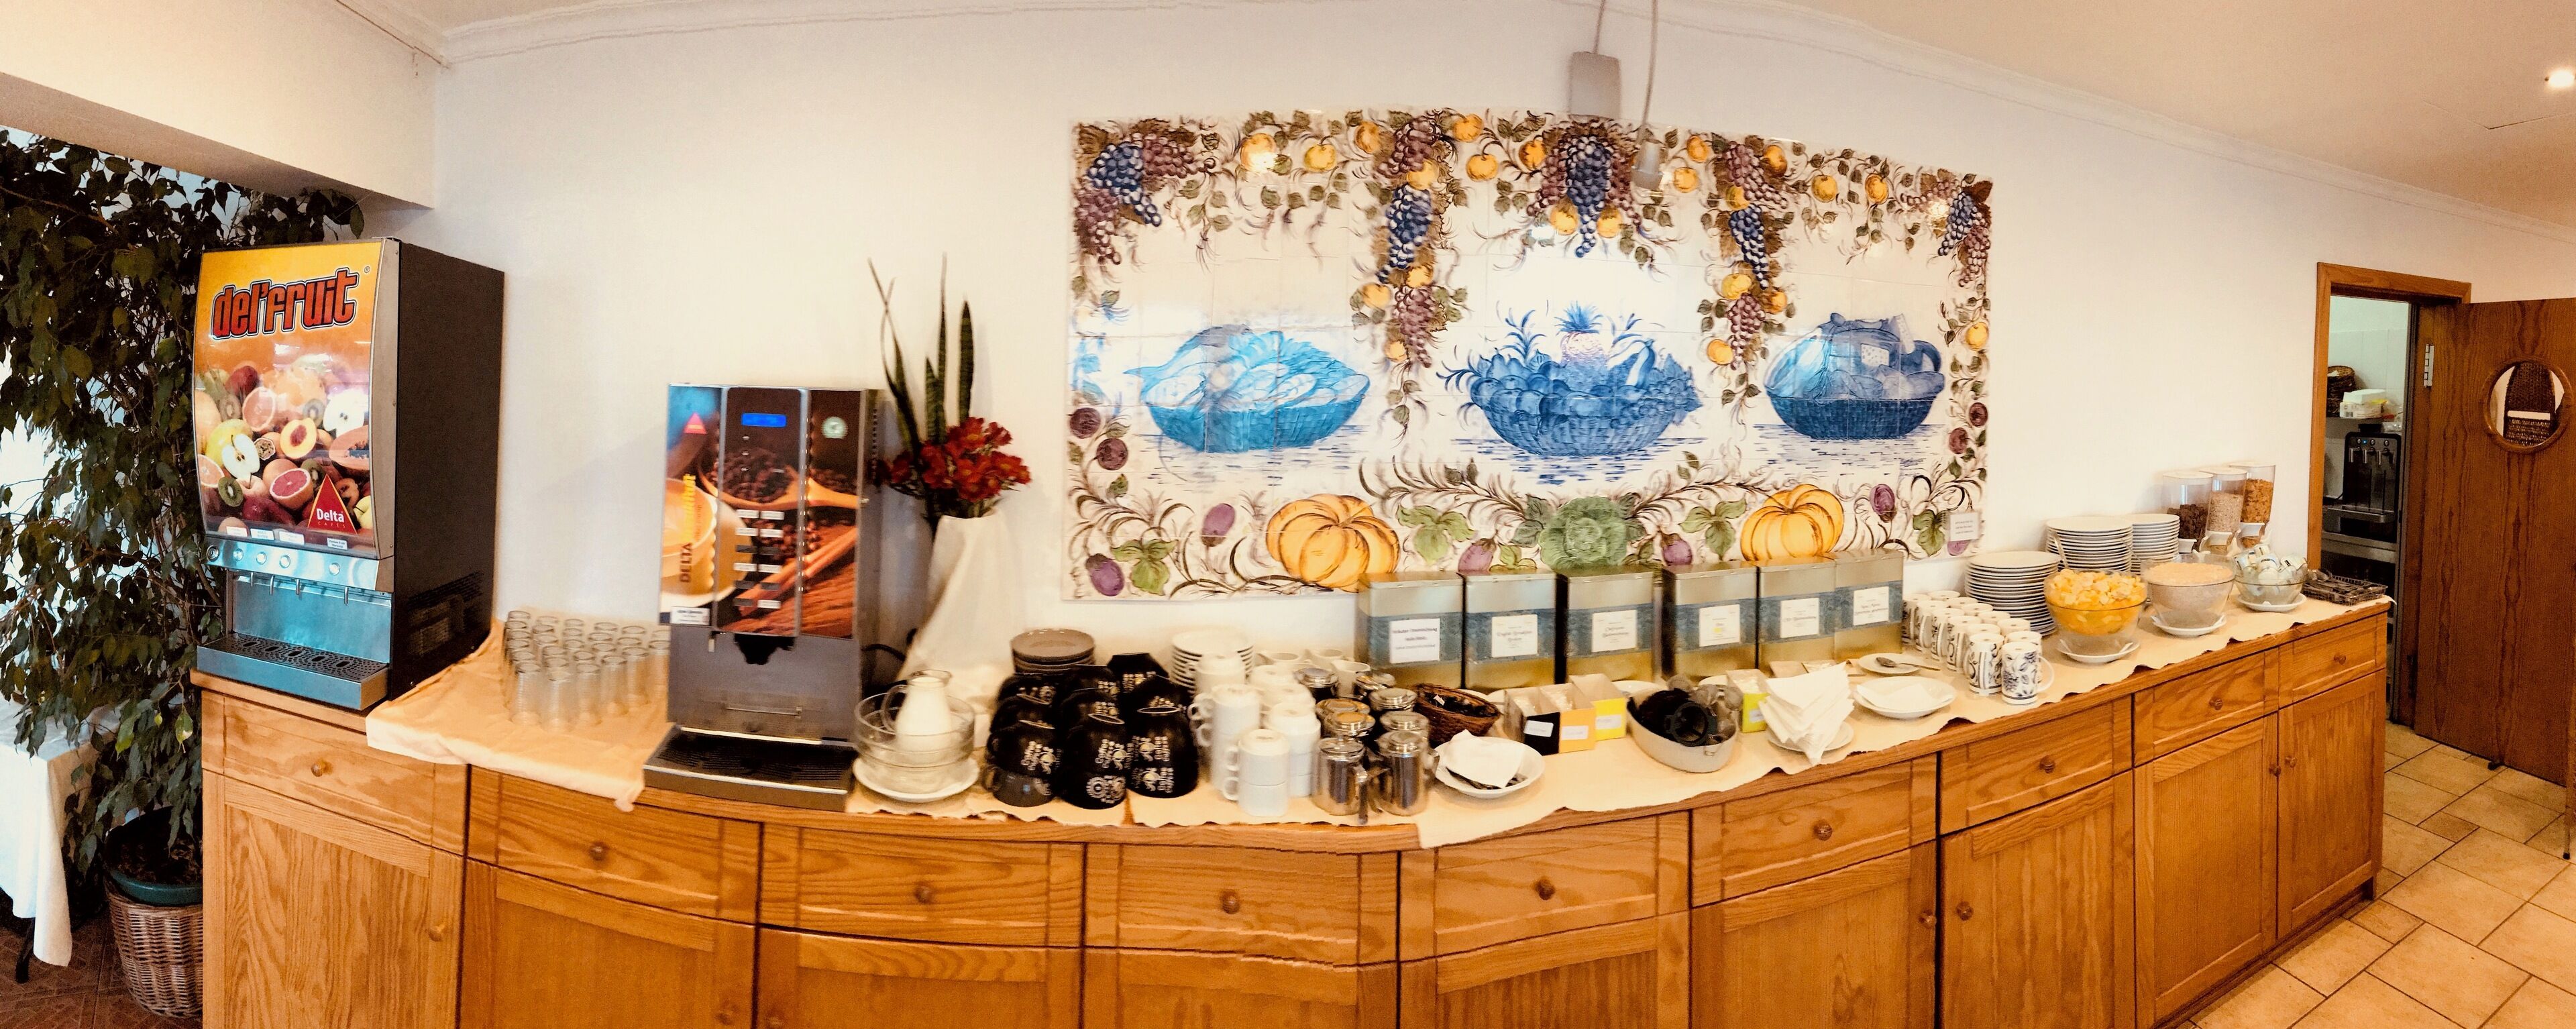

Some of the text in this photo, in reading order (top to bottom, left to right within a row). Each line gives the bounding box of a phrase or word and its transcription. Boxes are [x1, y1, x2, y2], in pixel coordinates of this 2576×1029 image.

[211, 268, 359, 339] del'fruit
[316, 508, 345, 523] Delta
[680, 543, 692, 583] DELTA
